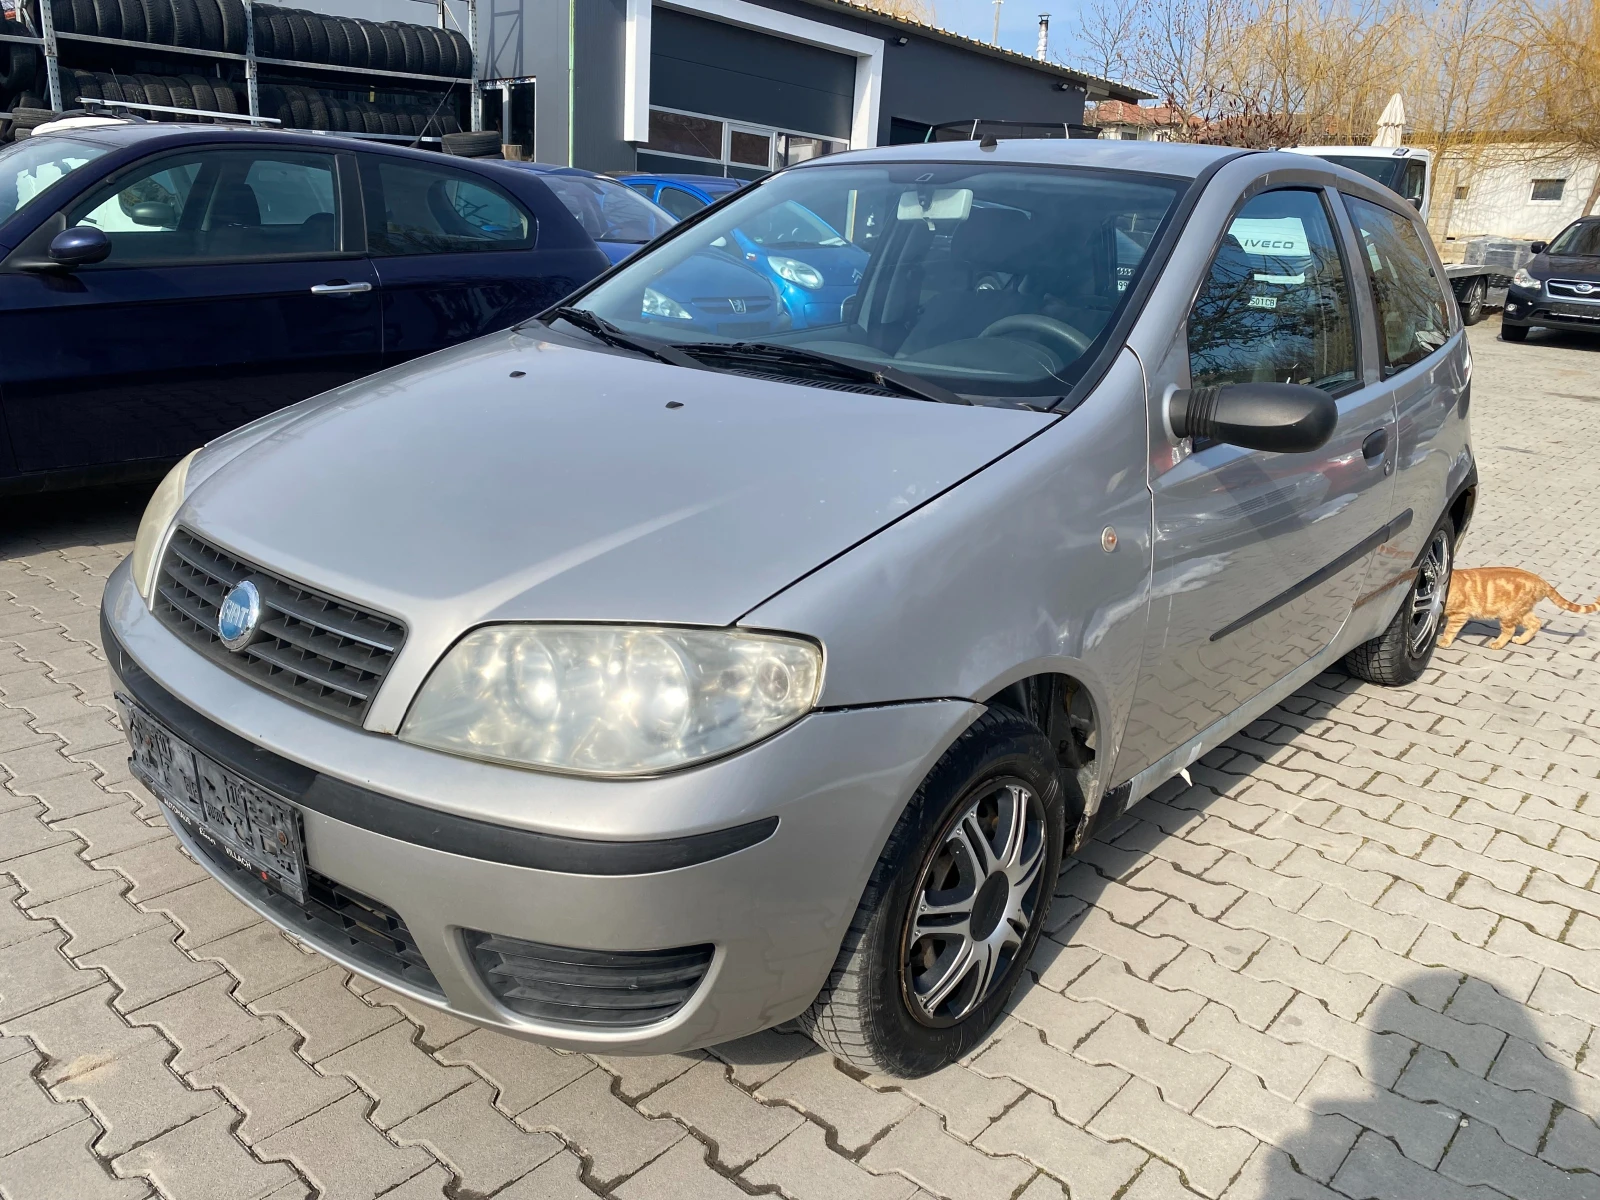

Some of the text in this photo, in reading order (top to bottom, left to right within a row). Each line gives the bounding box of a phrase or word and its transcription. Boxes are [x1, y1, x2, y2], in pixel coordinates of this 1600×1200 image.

[1244, 239, 1295, 250] IVECO
[221, 599, 250, 628] FIAT
[224, 845, 253, 870] VILLACH
